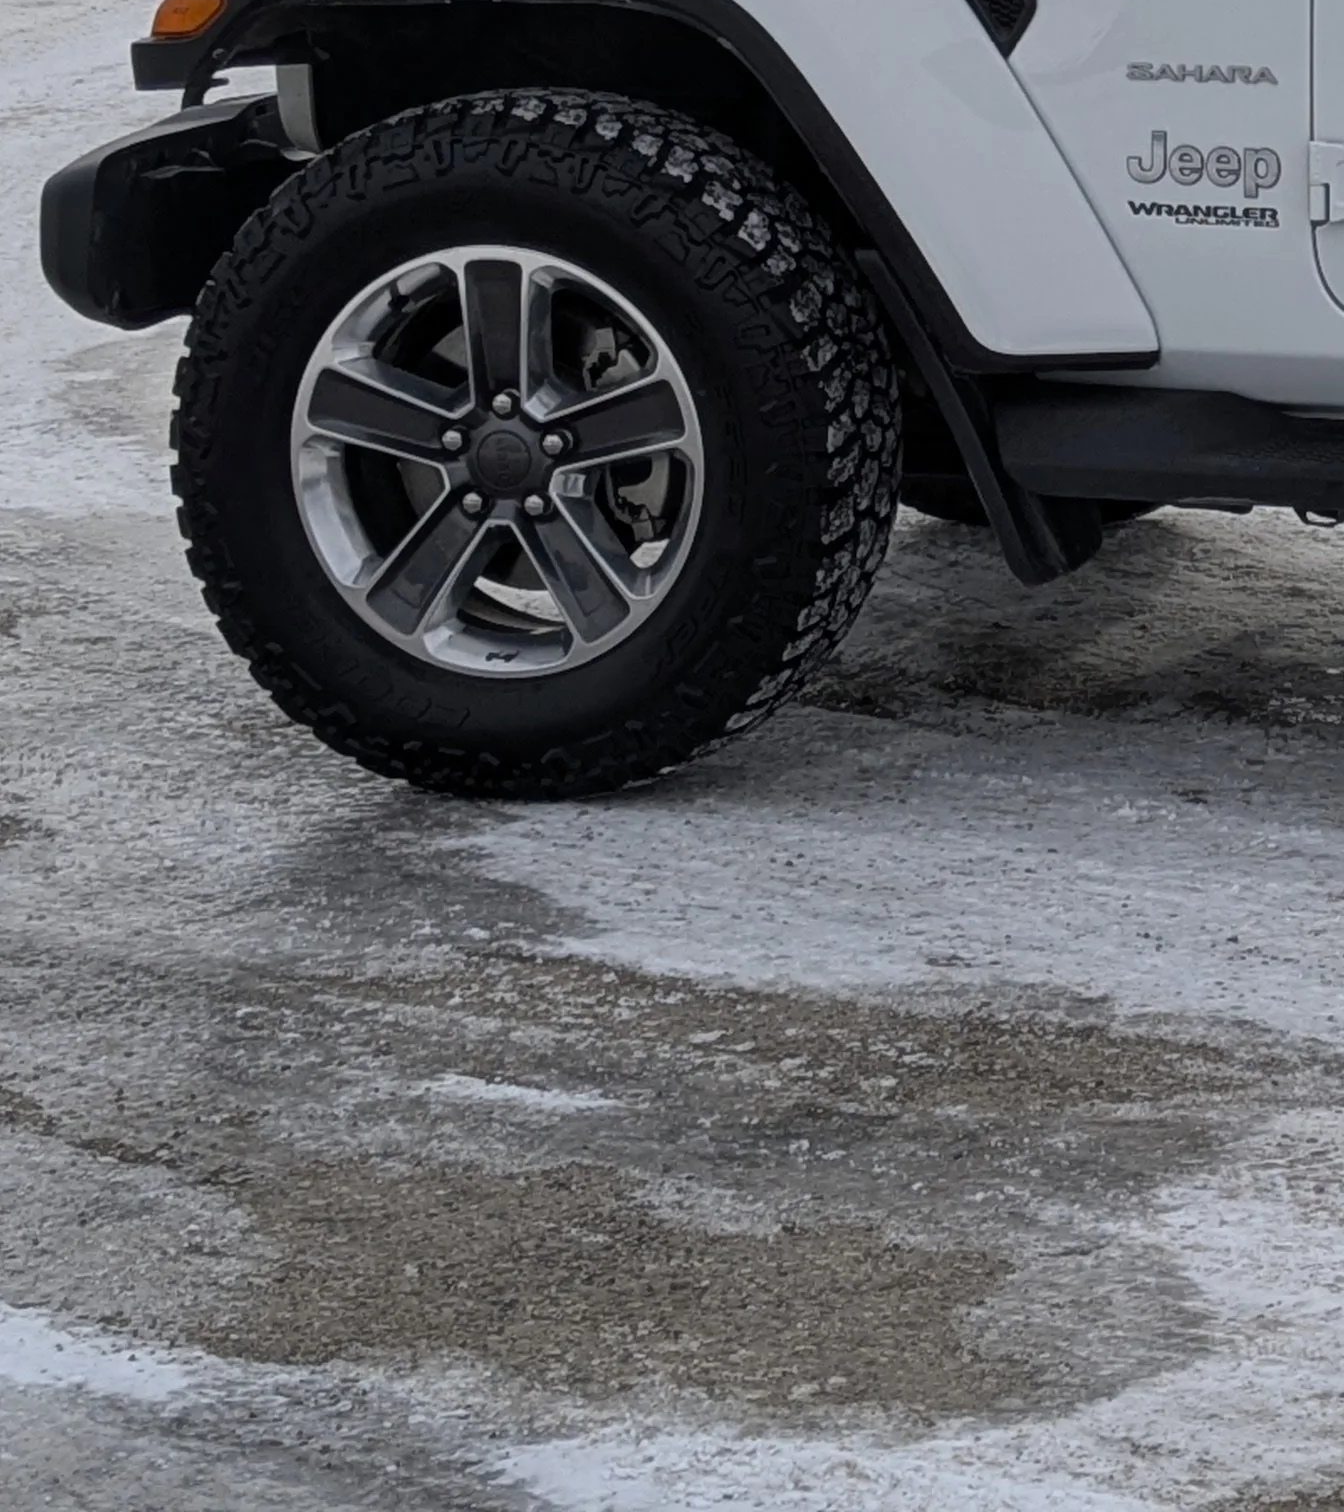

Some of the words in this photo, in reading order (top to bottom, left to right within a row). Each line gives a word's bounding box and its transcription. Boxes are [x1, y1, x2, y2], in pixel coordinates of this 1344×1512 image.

[1127, 62, 1278, 85] SAHARA
[1127, 130, 1281, 199] Jeep
[1127, 200, 1278, 220] WRANGLER
[1175, 218, 1280, 228] UNLIMITED
